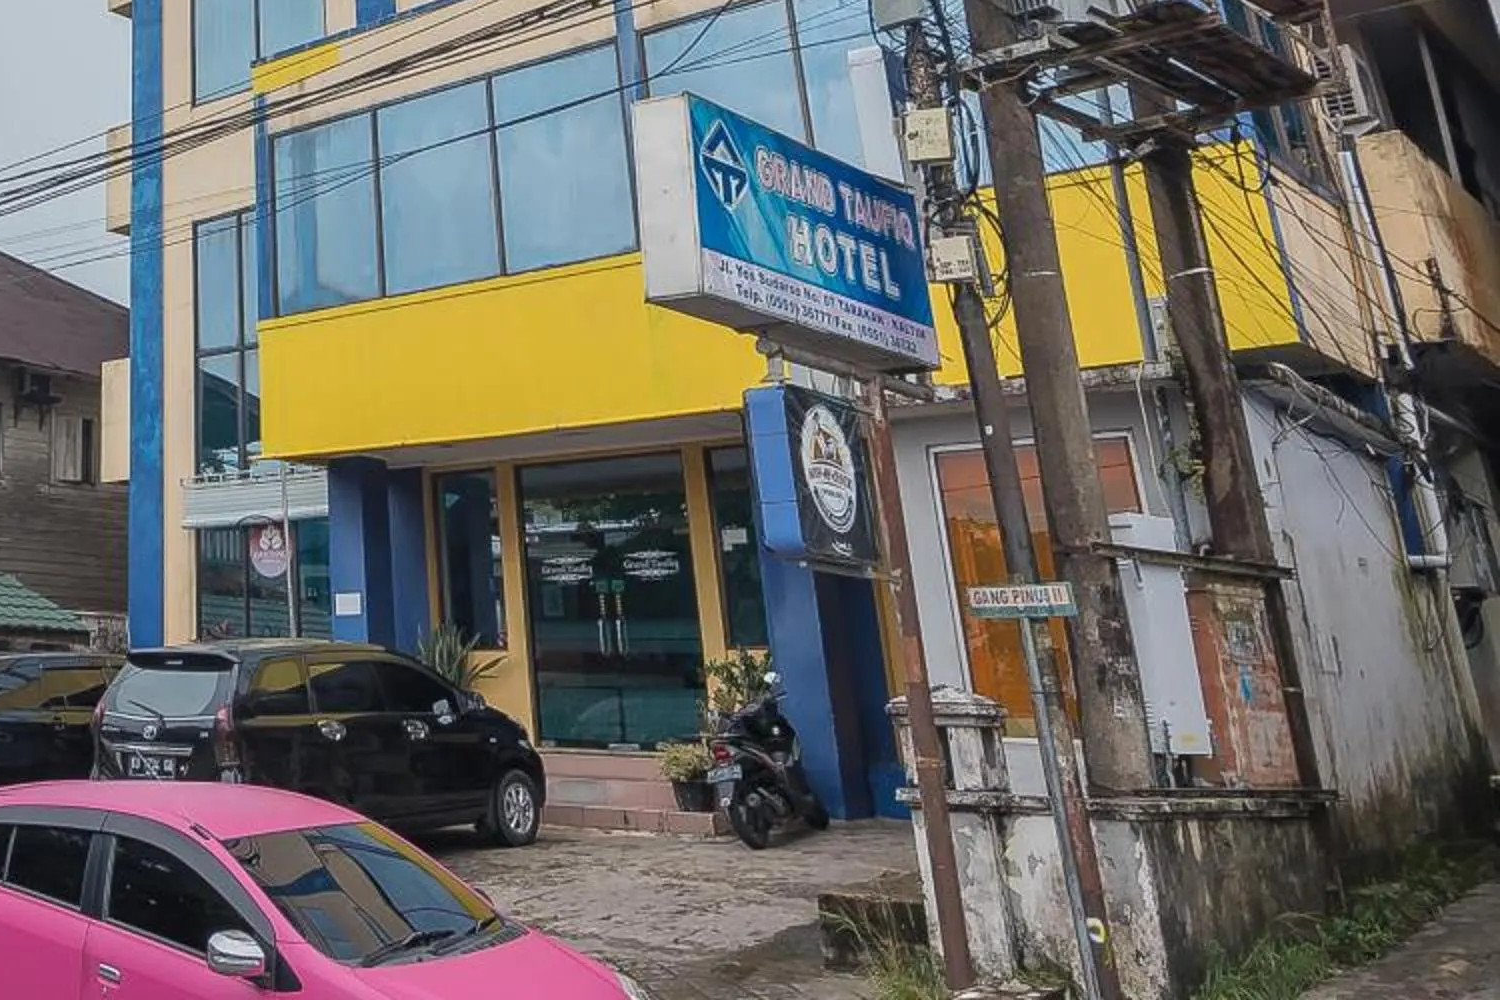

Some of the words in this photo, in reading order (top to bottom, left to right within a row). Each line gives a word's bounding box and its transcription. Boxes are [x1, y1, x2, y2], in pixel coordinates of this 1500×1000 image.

[756, 145, 836, 217] GRAND
[838, 180, 916, 249] TAUFIQ
[719, 260, 732, 275] Jl.
[787, 211, 900, 299] HOTEL
[973, 590, 1009, 605] GANG
